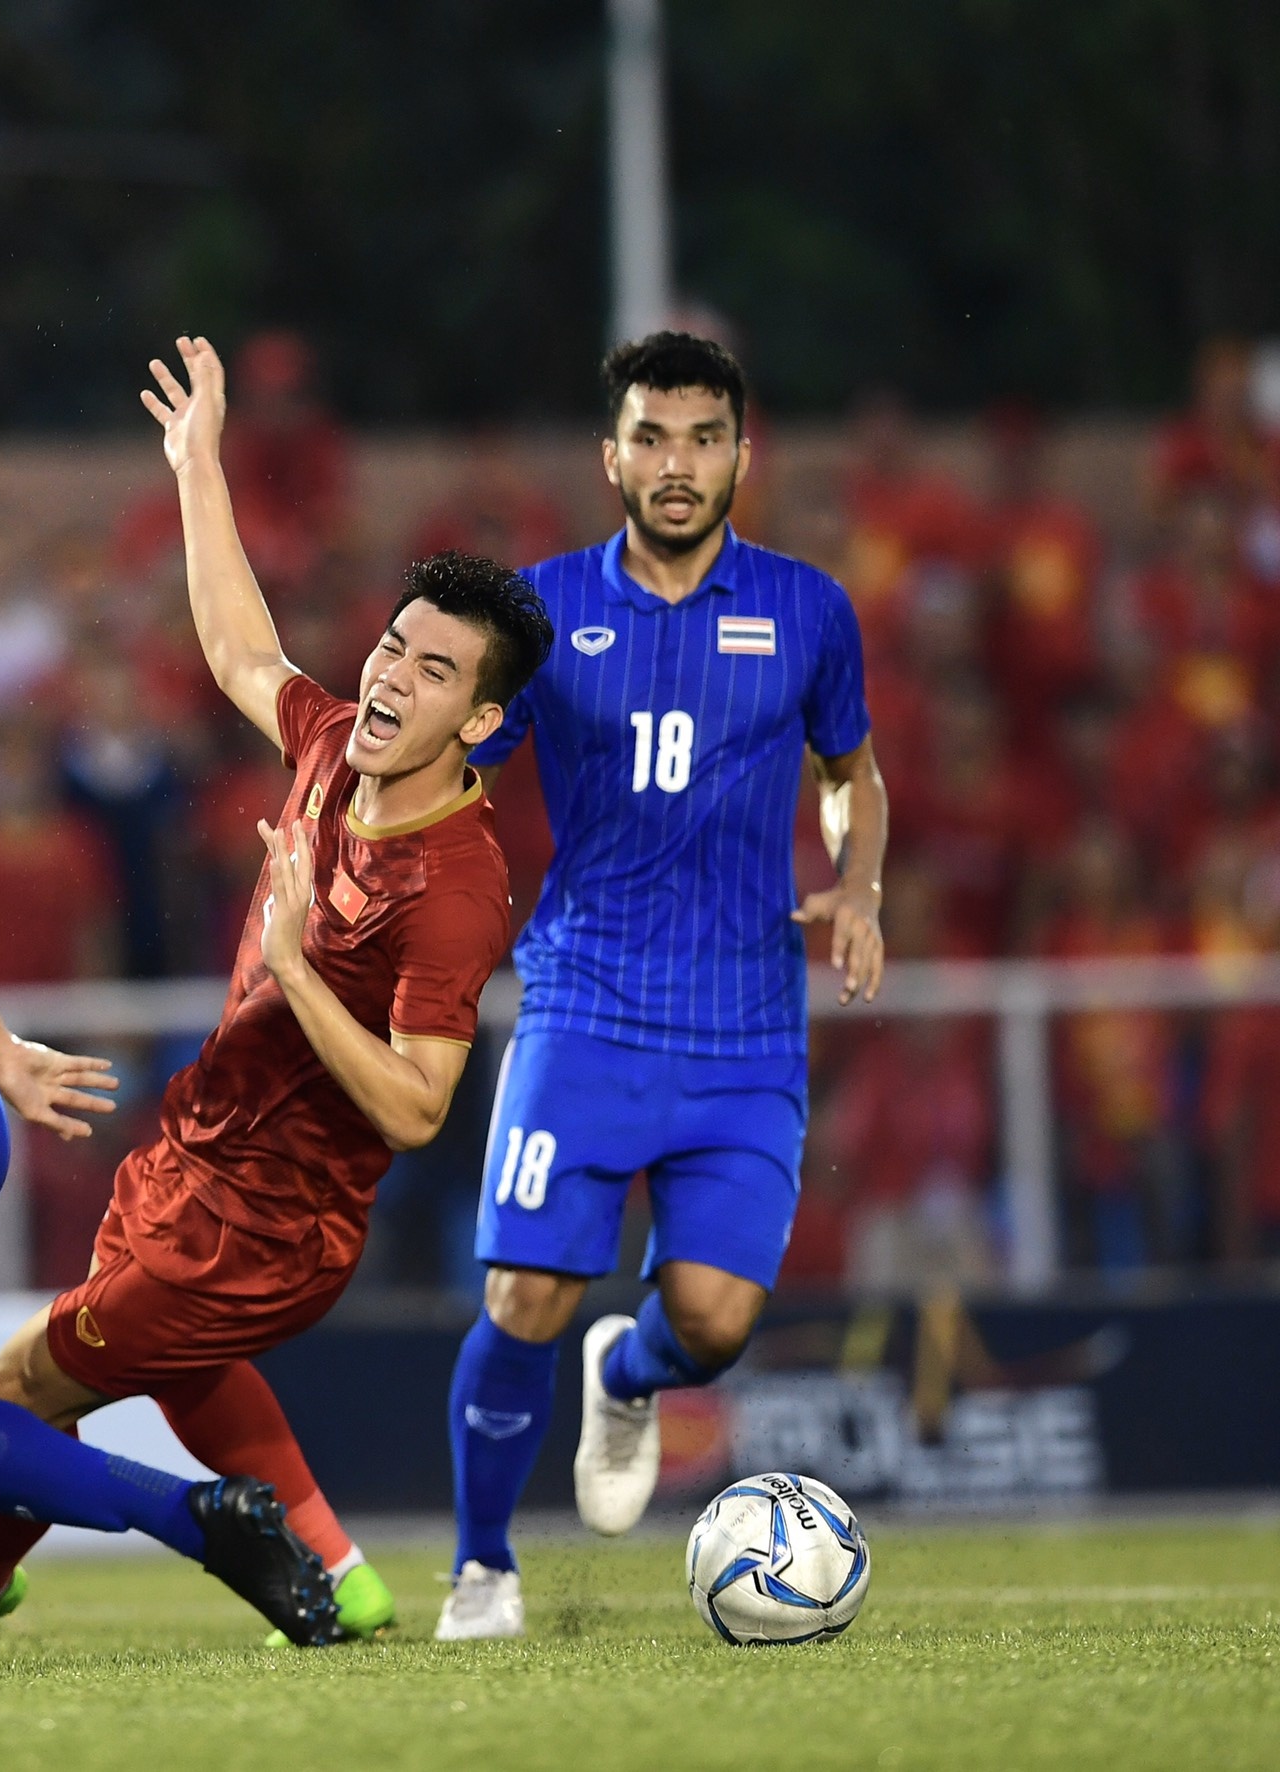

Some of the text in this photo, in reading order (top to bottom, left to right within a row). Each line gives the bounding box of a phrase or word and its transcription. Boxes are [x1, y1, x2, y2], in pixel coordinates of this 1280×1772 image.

[630, 710, 695, 794] 18
[495, 1126, 557, 1210] 18
[762, 1475, 818, 1531] molten
